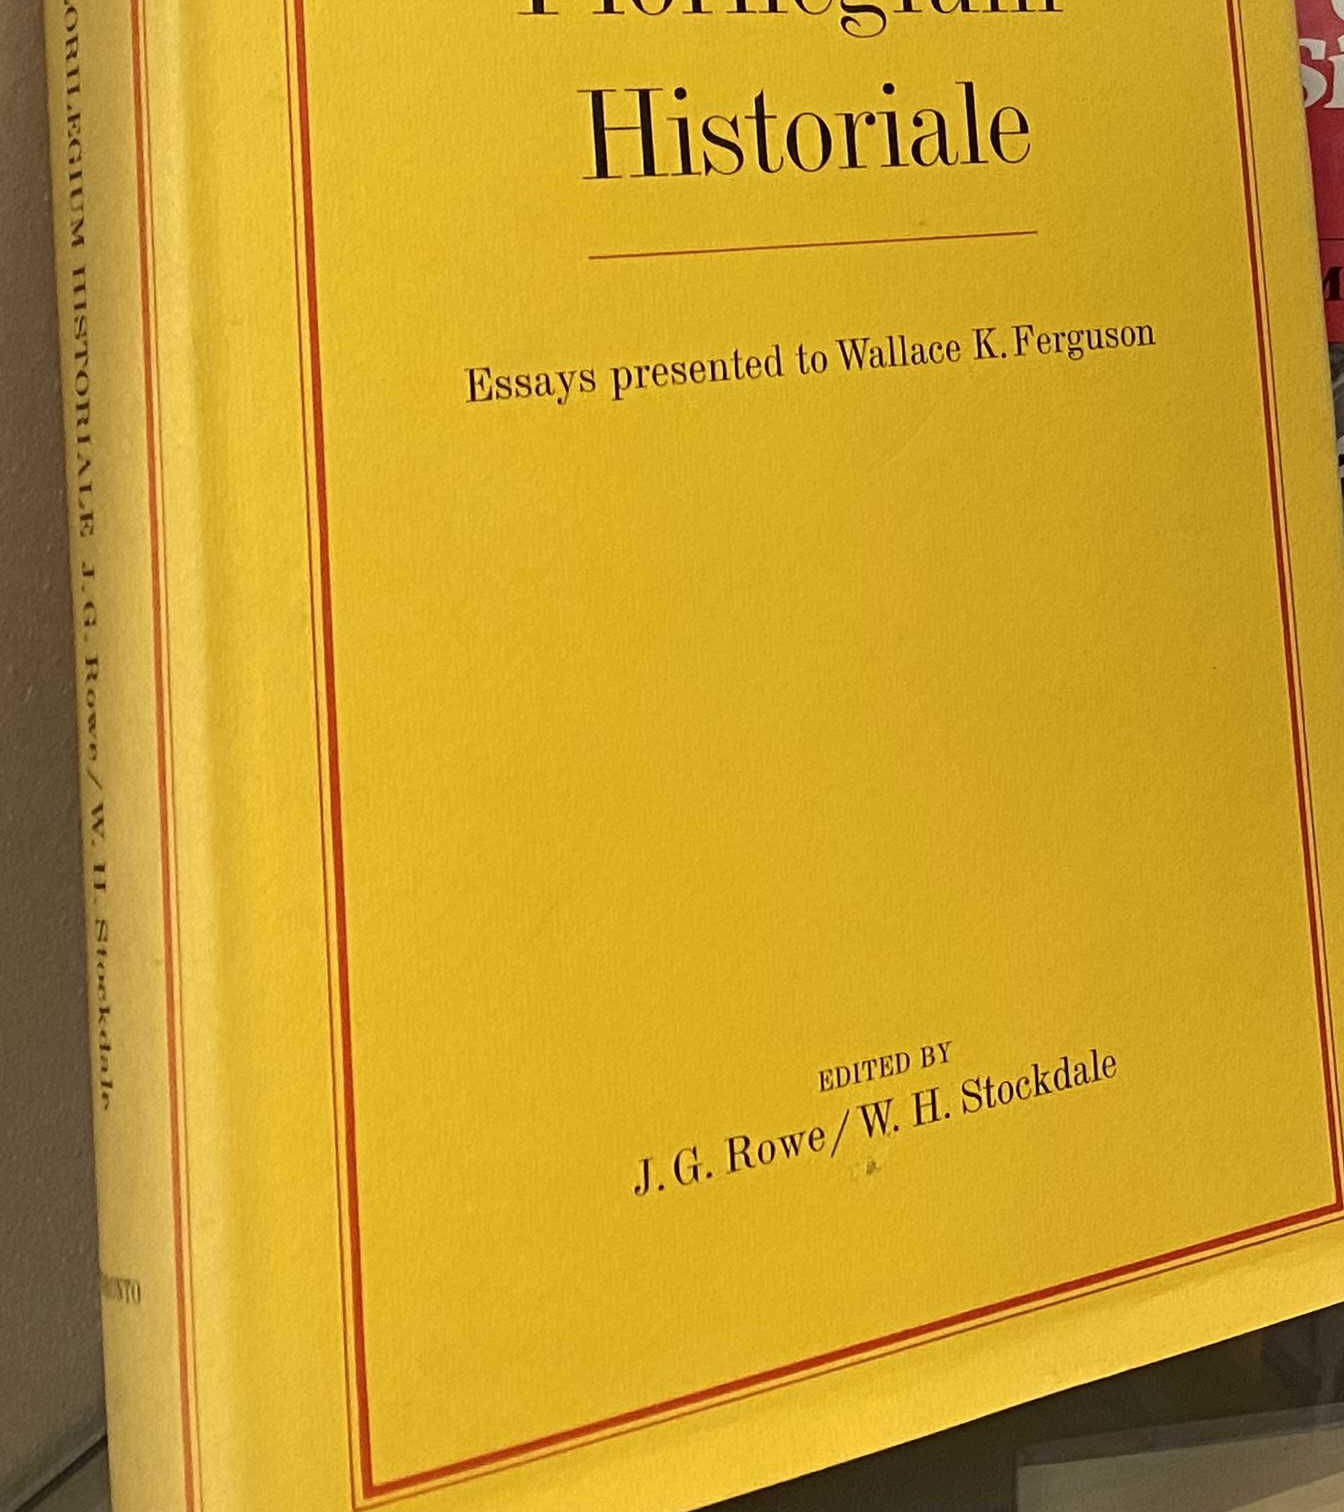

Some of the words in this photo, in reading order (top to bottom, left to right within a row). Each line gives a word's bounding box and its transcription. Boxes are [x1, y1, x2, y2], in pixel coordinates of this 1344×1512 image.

[578, 81, 1032, 180] Historiale
[464, 365, 597, 405] Essays
[610, 344, 784, 400] presented
[794, 347, 828, 375] to
[834, 335, 961, 372] Wallace
[971, 326, 1007, 360] K.
[1011, 321, 1156, 360] Ferguson
[817, 1051, 911, 1093] EDITED
[920, 1040, 953, 1069] BY
[960, 1047, 1118, 1115] Stockdale
